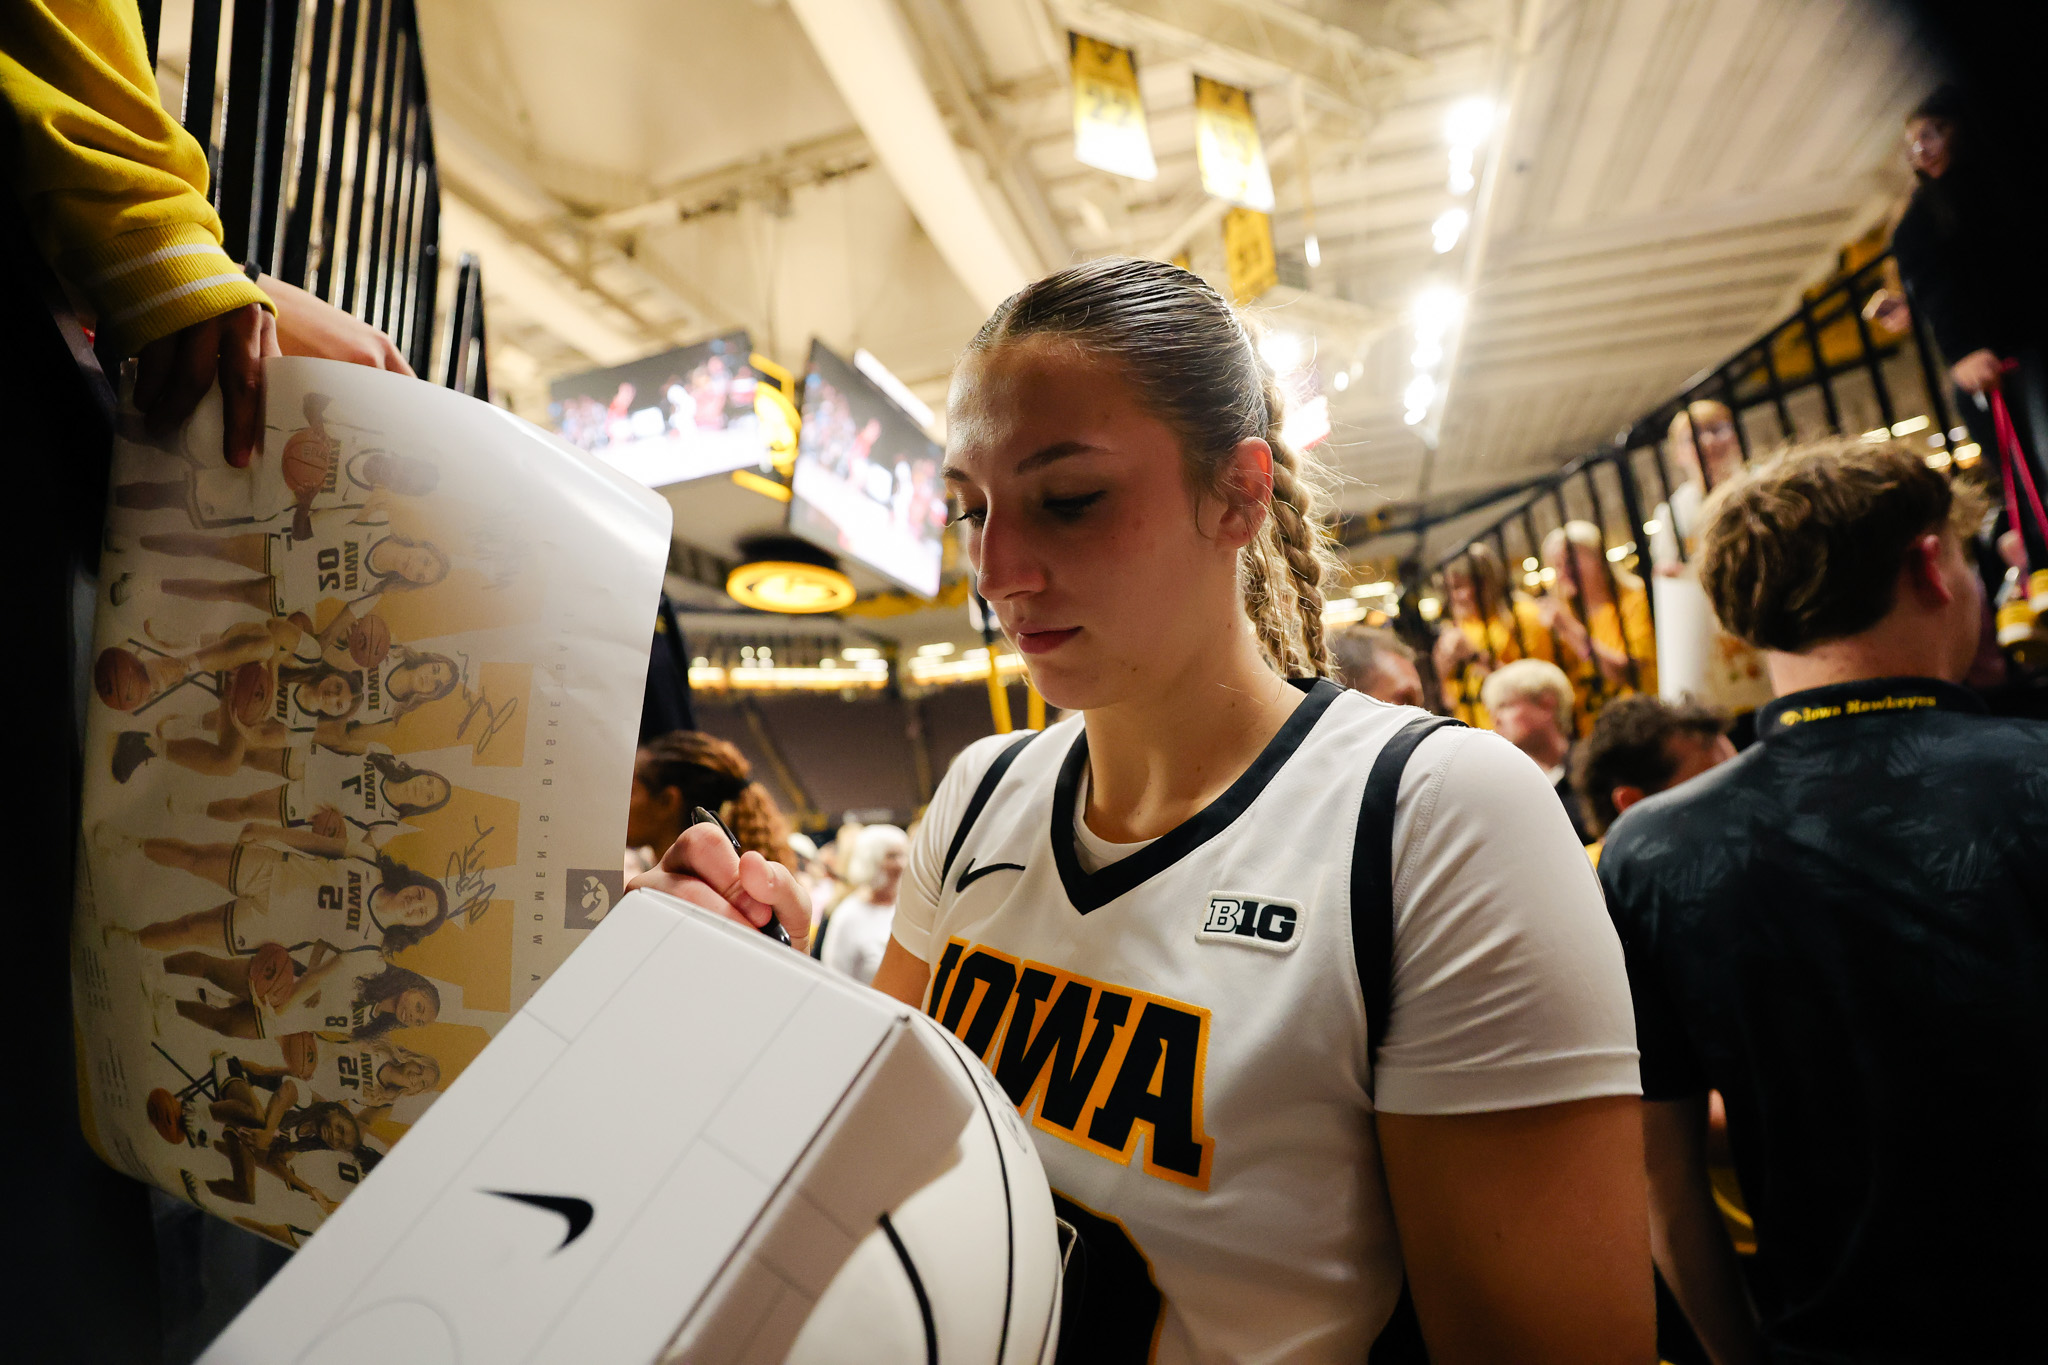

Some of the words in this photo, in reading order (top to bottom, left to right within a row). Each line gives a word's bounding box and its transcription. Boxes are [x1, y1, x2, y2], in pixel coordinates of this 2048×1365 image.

[1801, 706, 1842, 723] Iowa
[1846, 695, 1937, 715] Hawkeyes
[926, 937, 1212, 1188] IOWA
